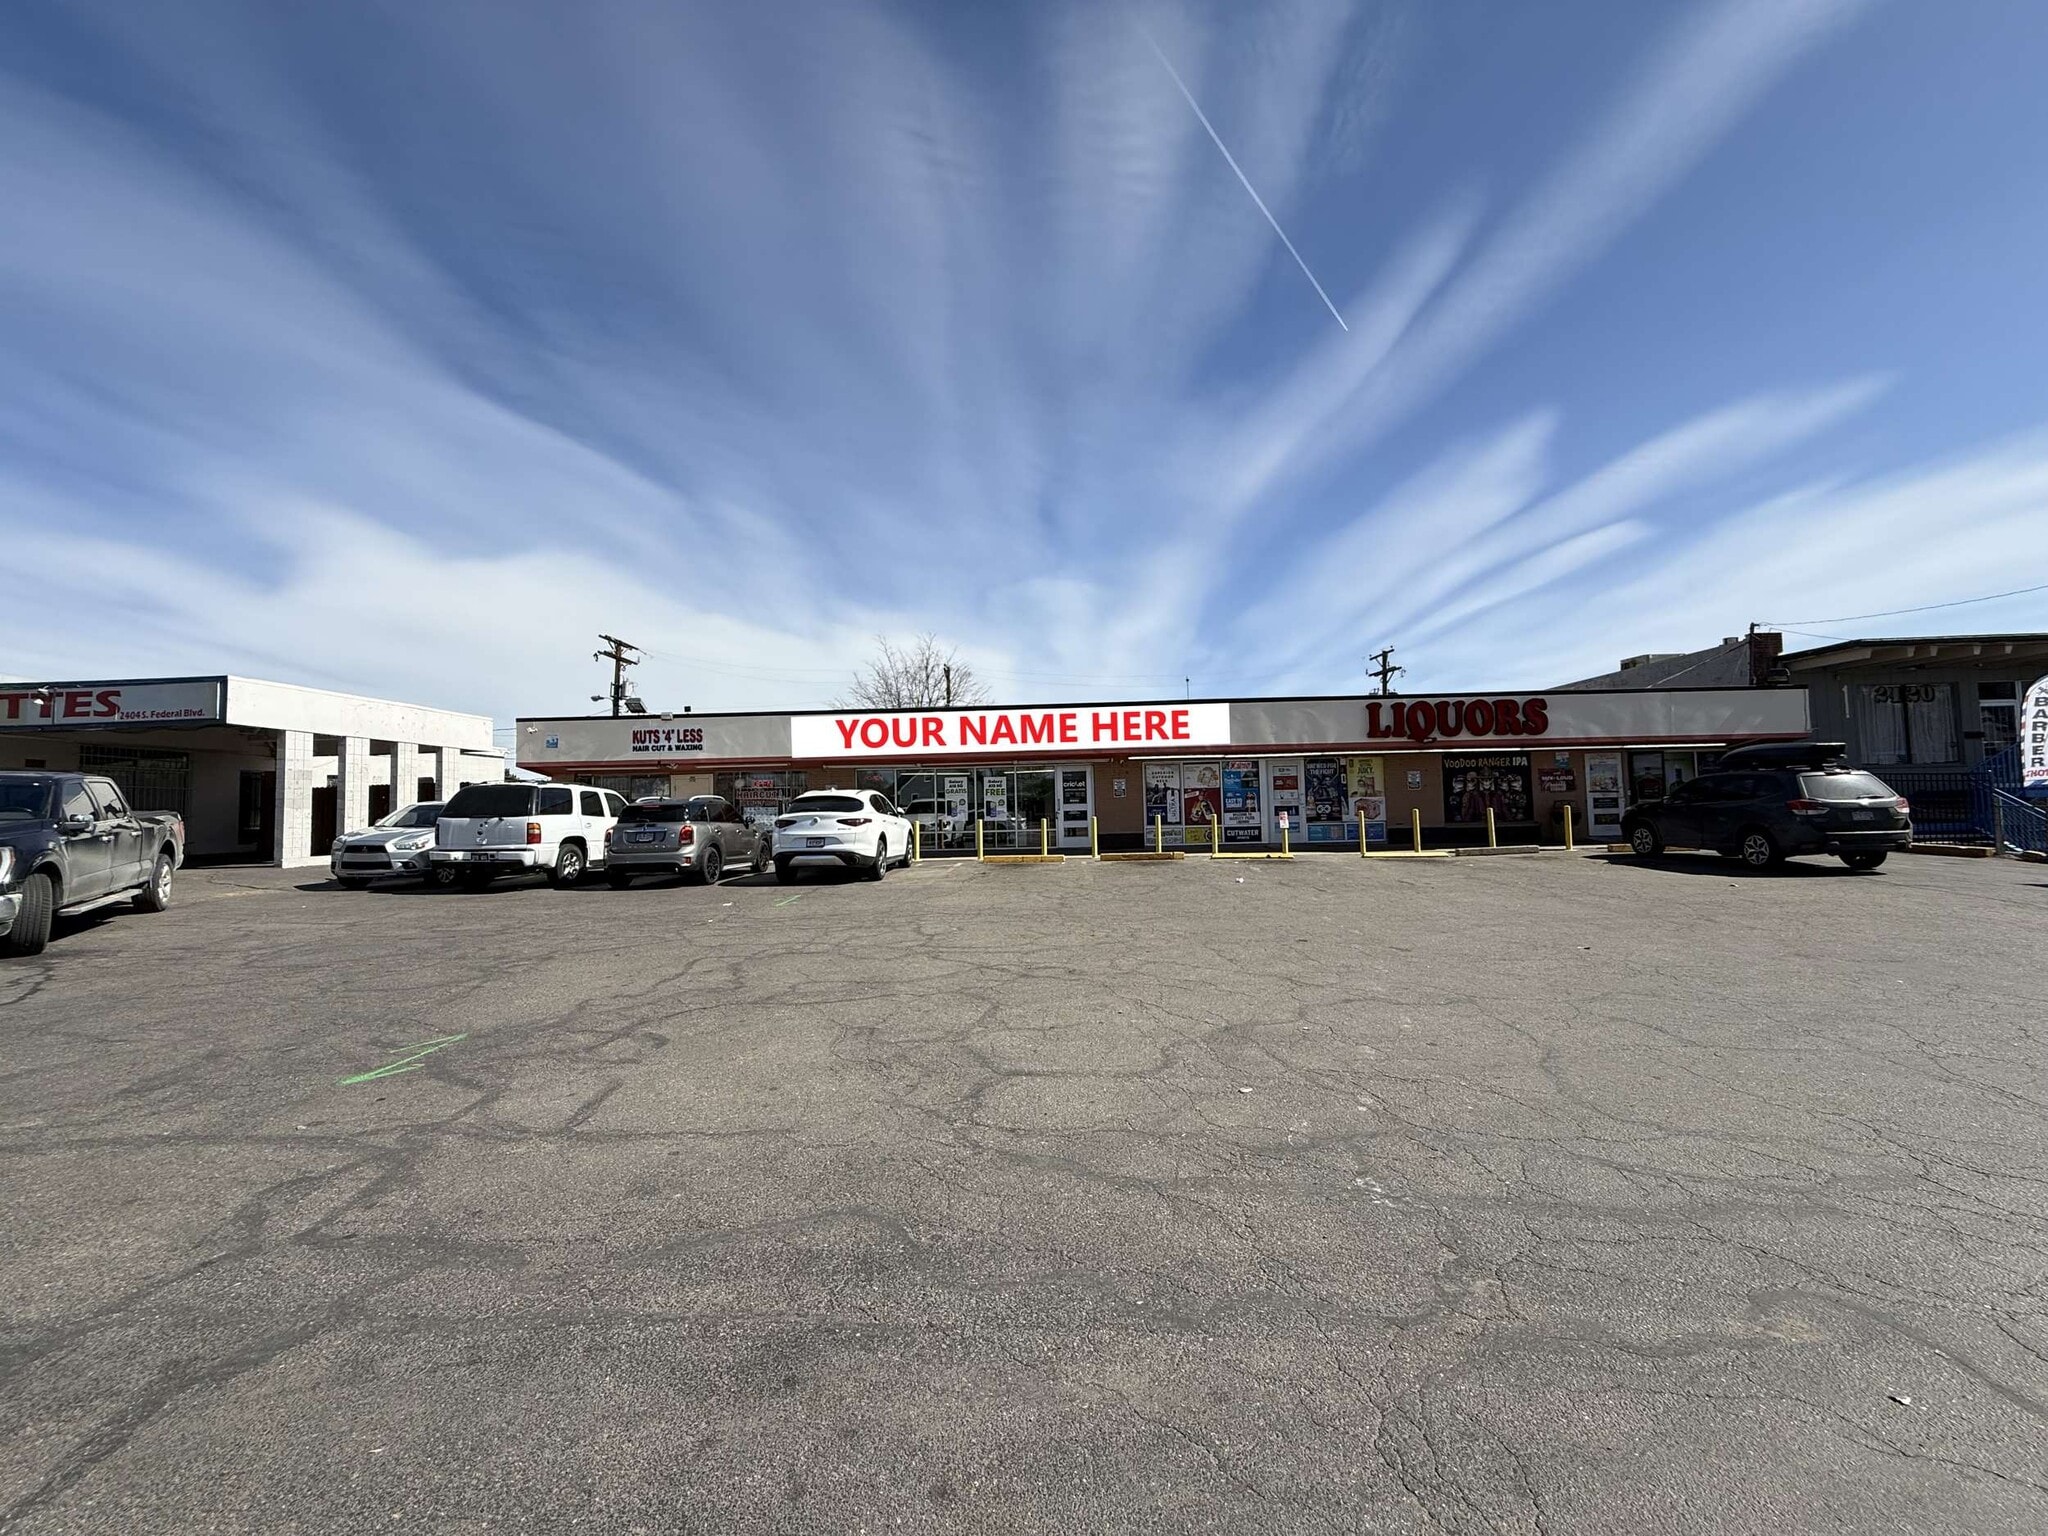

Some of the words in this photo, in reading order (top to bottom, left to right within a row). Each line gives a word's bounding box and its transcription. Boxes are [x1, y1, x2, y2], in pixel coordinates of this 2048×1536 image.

[120, 711, 141, 720] 2404
[150, 709, 182, 719] Federal
[183, 708, 206, 717] Blvd.
[1365, 698, 1549, 744] LIQUORS
[632, 729, 660, 744] KUTS
[676, 728, 703, 743] LESS
[835, 717, 947, 749] YOUR
[959, 713, 1078, 746] NAME
[1092, 710, 1190, 742] HERE
[2031, 696, 2048, 768] BARBER
[1443, 758, 1477, 769] VOODOO
[1478, 756, 1511, 767] RANGER
[1512, 756, 1529, 766] IPA
[736, 791, 778, 799] HAIRCUT
[985, 788, 1006, 796] FREE
[1226, 829, 1259, 837] CUTWATER
